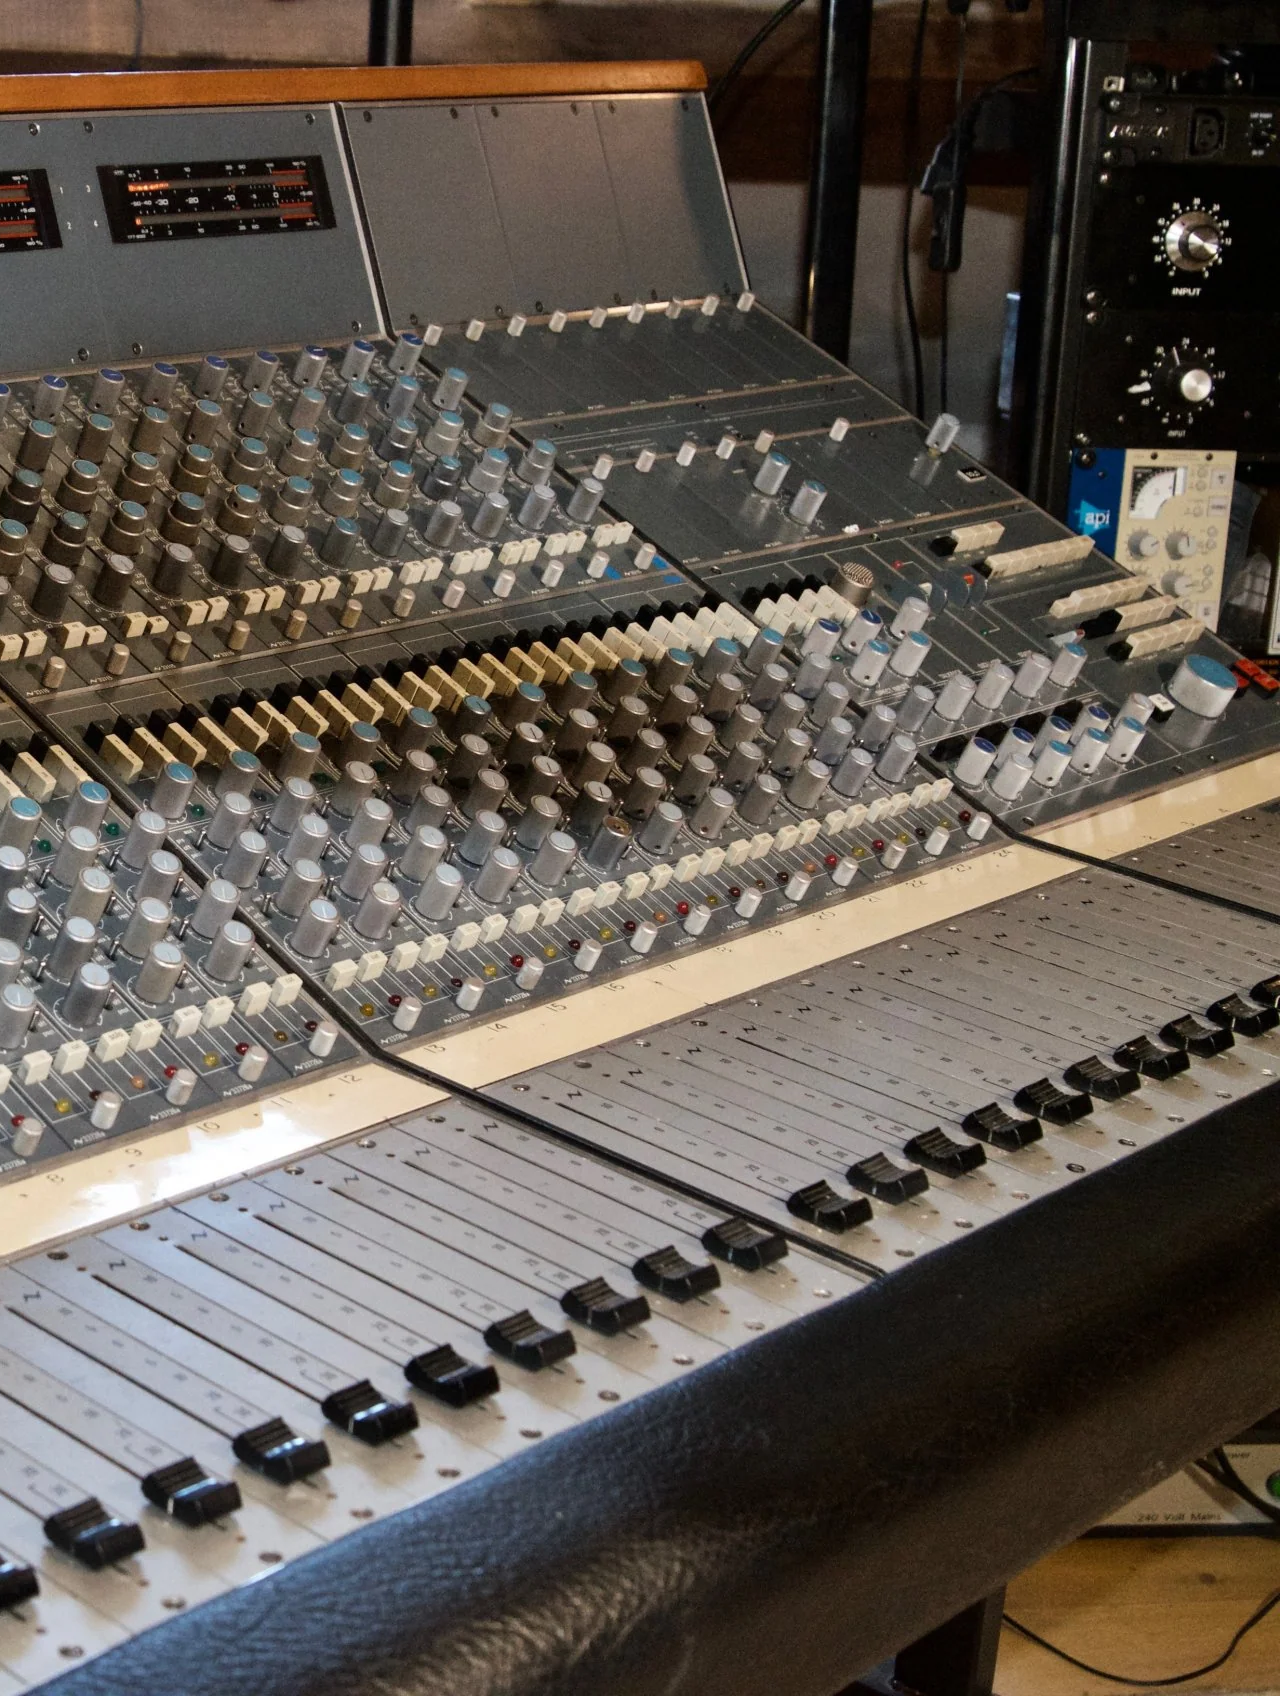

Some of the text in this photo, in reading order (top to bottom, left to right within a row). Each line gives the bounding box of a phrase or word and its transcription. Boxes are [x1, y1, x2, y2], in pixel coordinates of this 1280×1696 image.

[1171, 287, 1202, 296] INPUT
[1085, 510, 1110, 529] api
[602, 982, 625, 993] 16
[545, 1002, 568, 1014] 15
[485, 1021, 510, 1034] 14
[423, 1043, 447, 1055] 13
[337, 1073, 363, 1085] 12
[195, 1120, 221, 1134] 10
